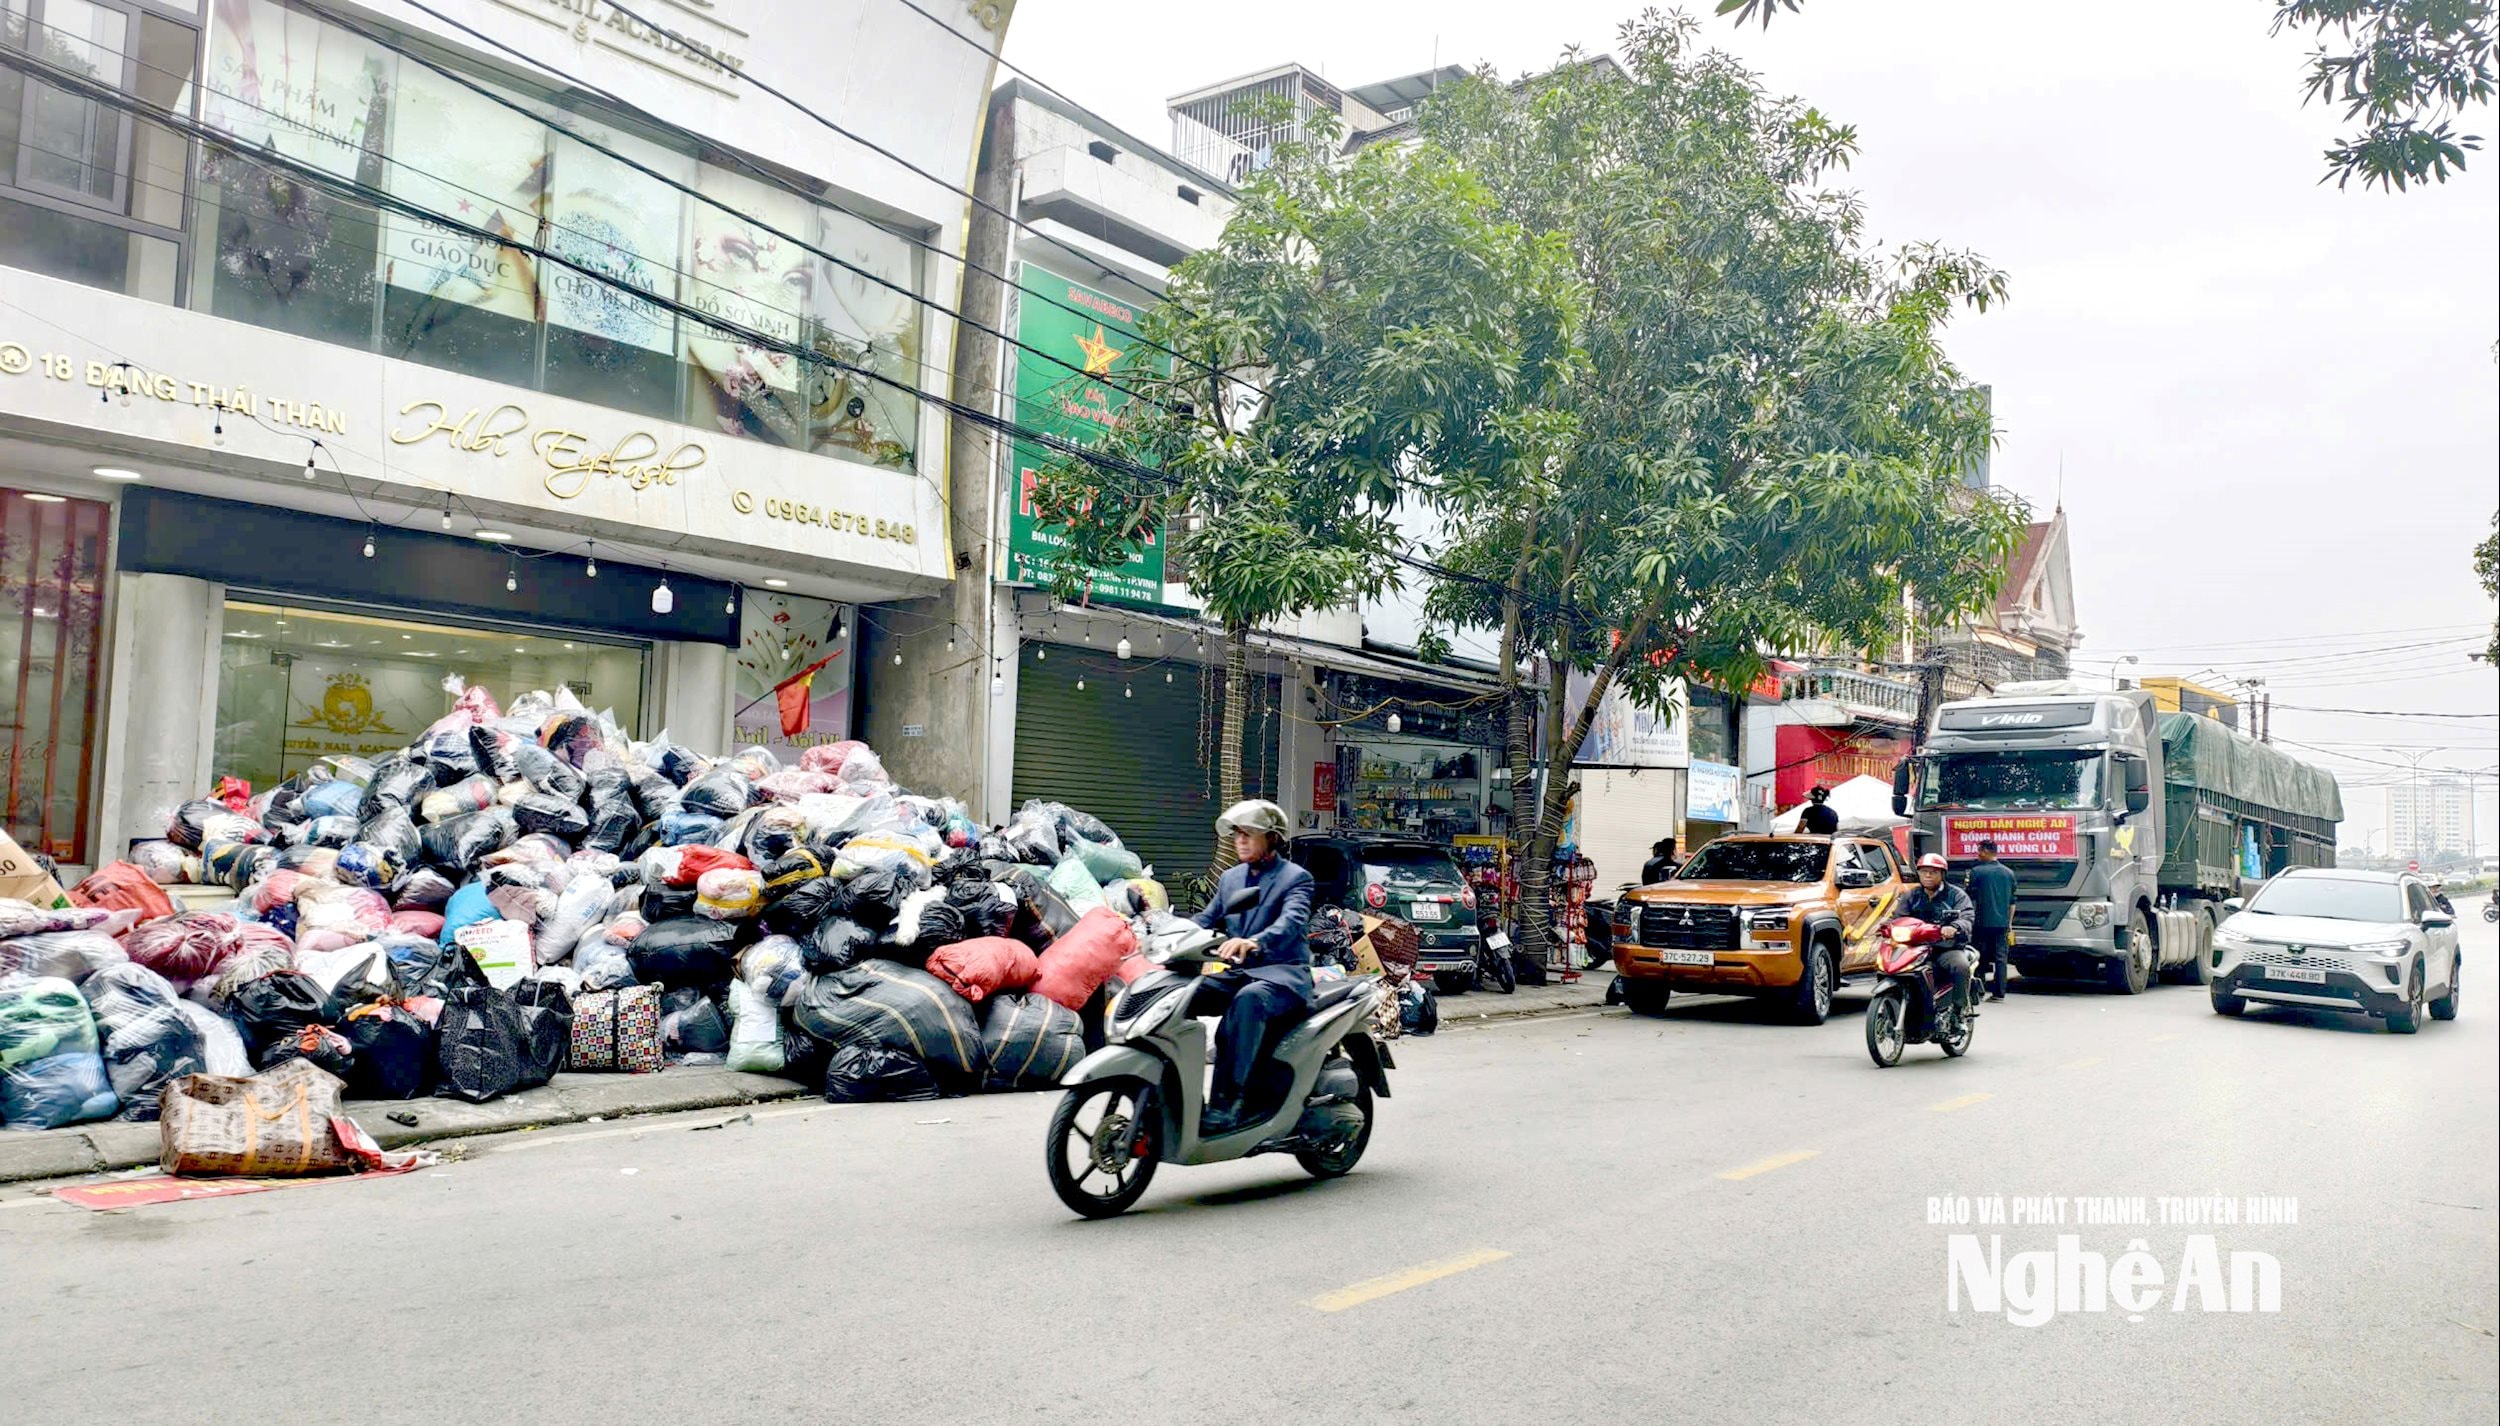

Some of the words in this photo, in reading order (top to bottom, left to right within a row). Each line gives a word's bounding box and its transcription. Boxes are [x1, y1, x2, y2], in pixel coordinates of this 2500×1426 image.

[604, 9, 745, 79] ACADEMY
[410, 238, 462, 264] GIÁO
[468, 253, 510, 278] DỤC
[1067, 286, 1133, 324] SAVABECO
[750, 312, 790, 336] SINH
[39, 351, 75, 381] 18
[187, 380, 258, 417] THÁI
[267, 396, 347, 435] THÂN
[764, 496, 916, 545] 0964.678.848
[1031, 530, 1048, 544] BIA
[1953, 818, 1987, 830] NGƯỜI
[1990, 818, 2013, 829] DÂN
[2016, 818, 2047, 831] NGHỆ
[2050, 818, 2067, 829] AN
[2008, 843, 2039, 854] VÙNG
[1663, 952, 1710, 963] 37C-527.29
